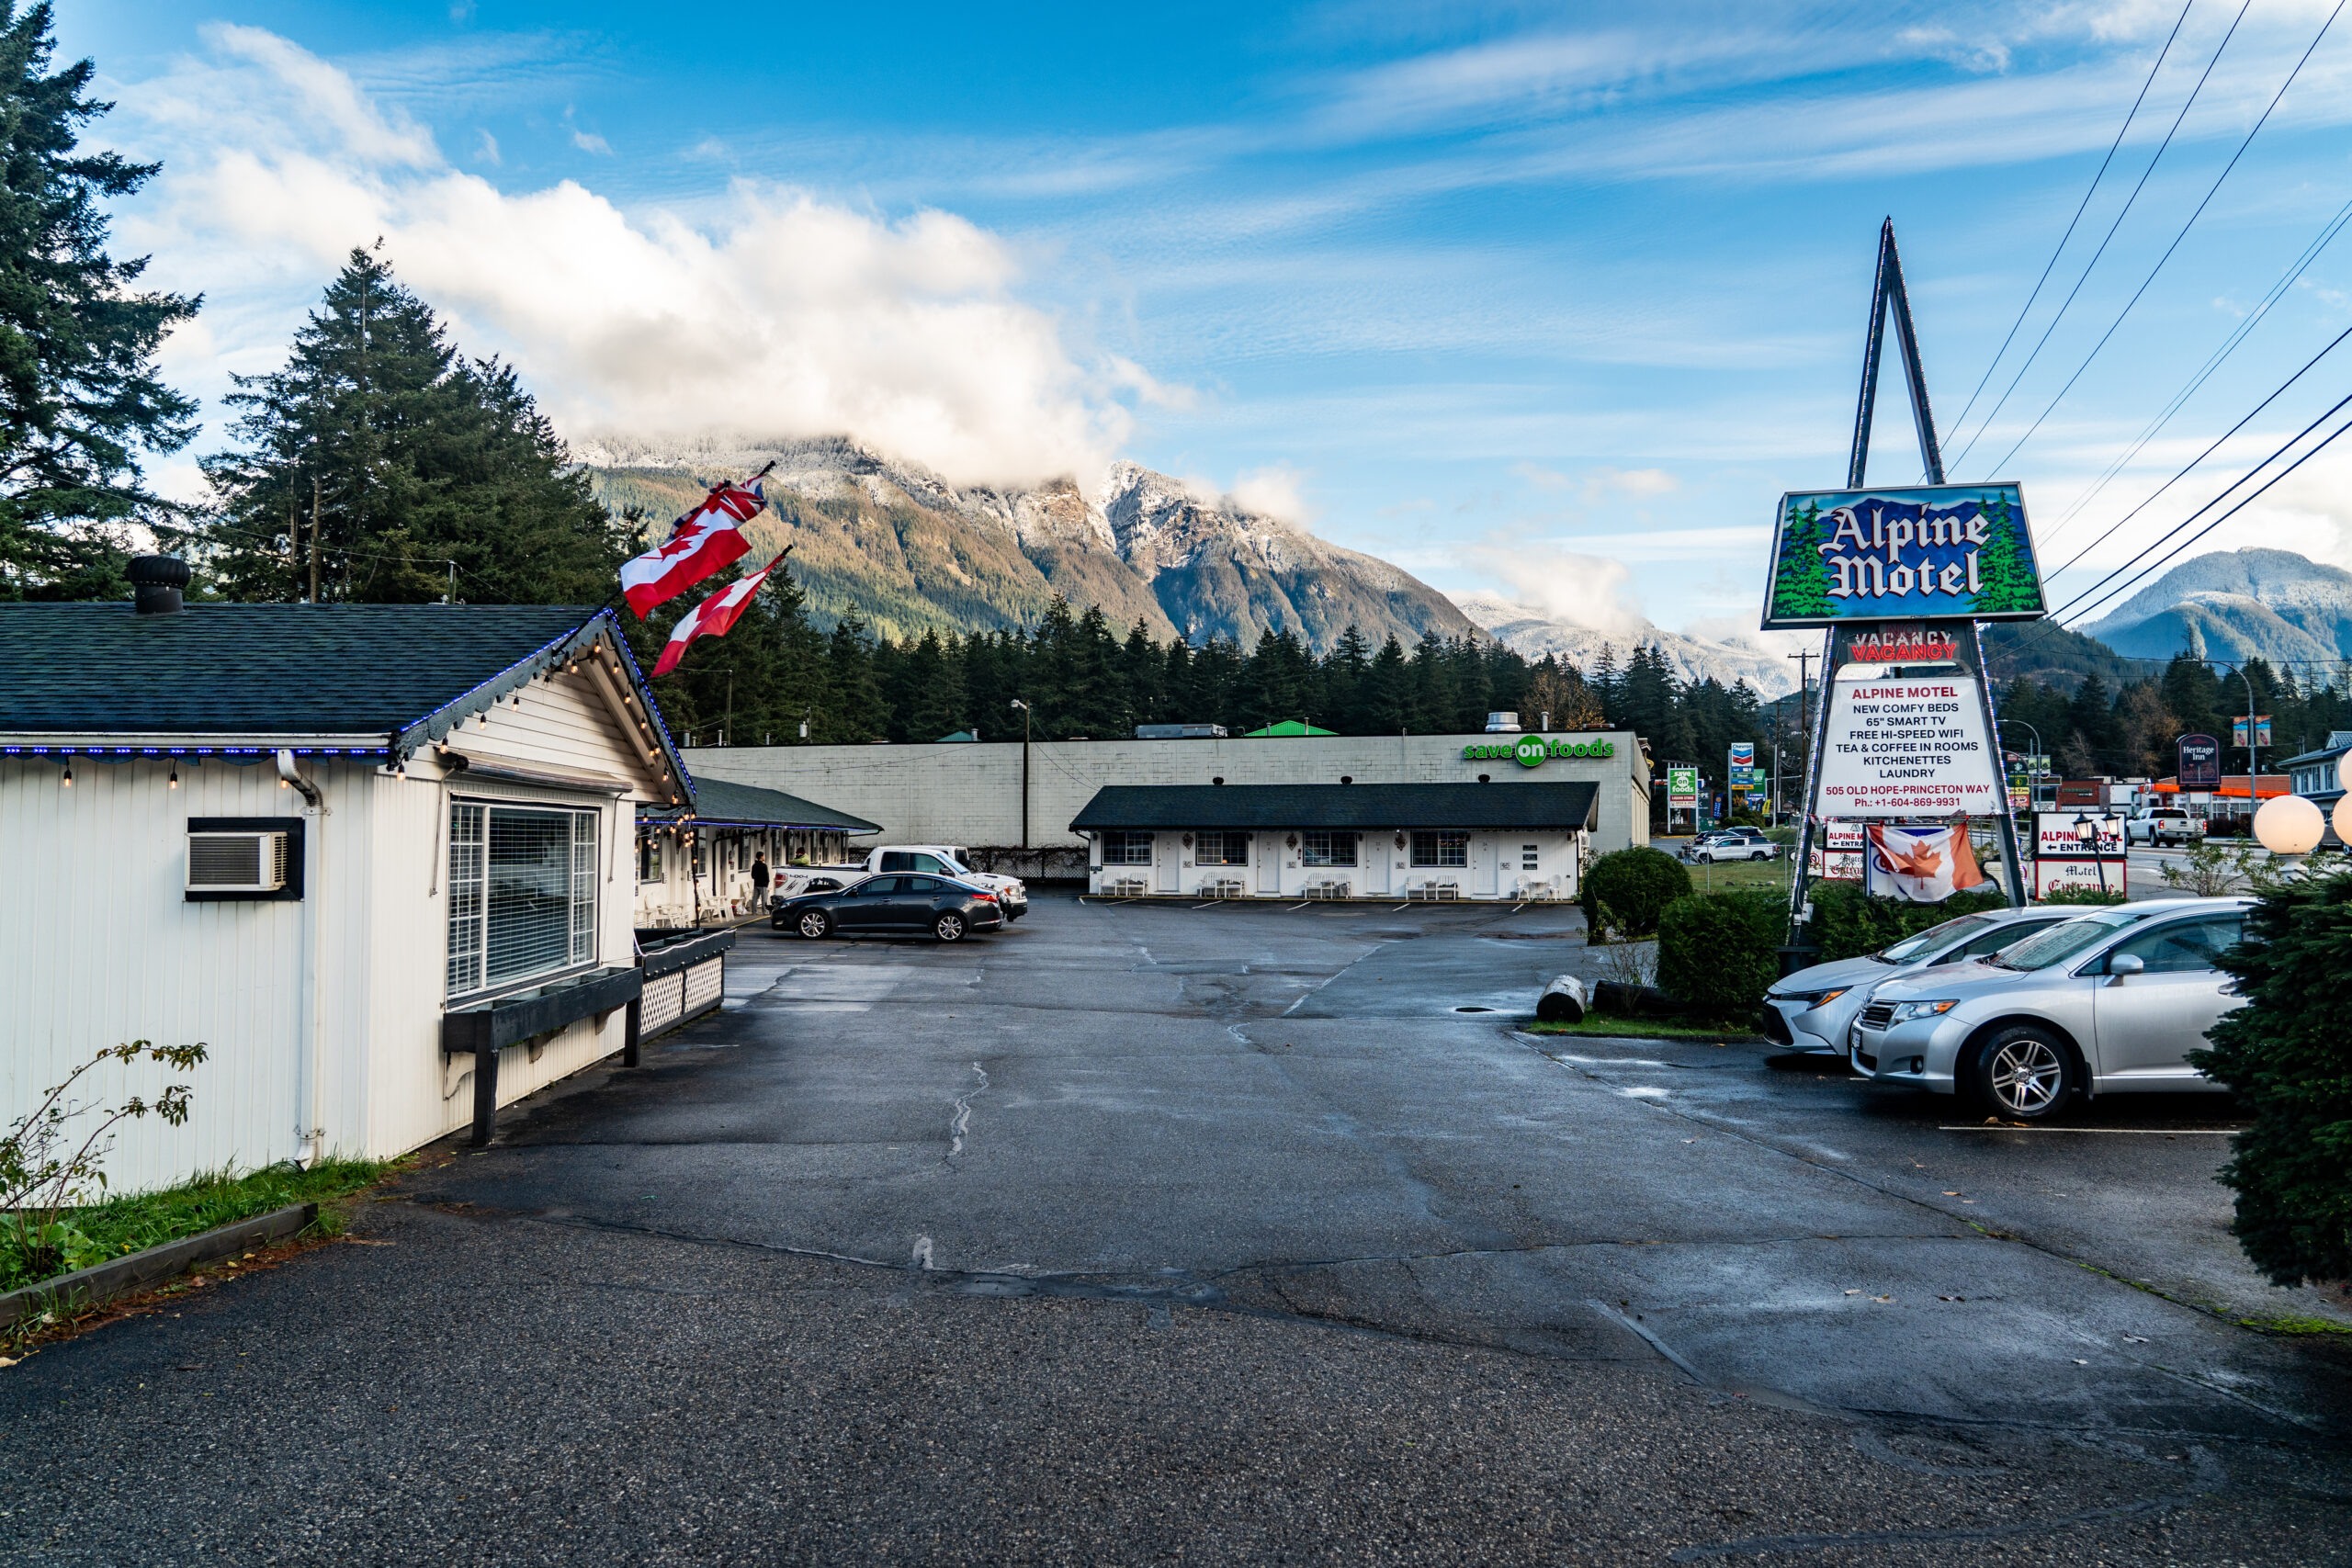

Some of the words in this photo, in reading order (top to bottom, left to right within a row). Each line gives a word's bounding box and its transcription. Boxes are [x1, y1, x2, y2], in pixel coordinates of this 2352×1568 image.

[1817, 502, 1992, 565] Alpine
[1826, 549, 1984, 600] Motel
[1851, 643, 1957, 661] VACANCY
[1852, 688, 1904, 699] ALPINE
[1907, 686, 1958, 698] MOTEL
[1853, 705, 1880, 714] NEW
[1883, 704, 1925, 714] COMFY
[1928, 703, 1959, 712] BEDS
[1866, 717, 1884, 727] 65"
[1887, 716, 1928, 727] SMART
[1930, 716, 1946, 726] TV
[1849, 730, 1879, 739] FREE
[1881, 729, 1936, 739] HI-SPEED
[1938, 728, 1963, 739] WIFI
[1464, 745, 1512, 759] save
[1518, 744, 1544, 758] on
[1550, 739, 1615, 758] foods
[1836, 744, 1859, 753] TEA
[1860, 744, 1869, 753] &
[1871, 742, 1917, 752] COFFEE
[1919, 742, 1931, 751] IN
[1934, 741, 1979, 751] ROOMS
[2183, 746, 2214, 756] Heritage
[1863, 755, 1951, 766] KITCHENETTES
[1879, 769, 1936, 779] LAUNDRY
[1672, 784, 1694, 793] foods
[1826, 786, 1845, 795] 505
[1847, 785, 1868, 795] OLD
[1871, 784, 1962, 795] HOPE-PRINCETON
[1965, 784, 1990, 794] WAY
[1854, 798, 1872, 807] Ph.:
[1875, 796, 1961, 807] +1-604-869-9931
[2041, 831, 2079, 841] ALPINE
